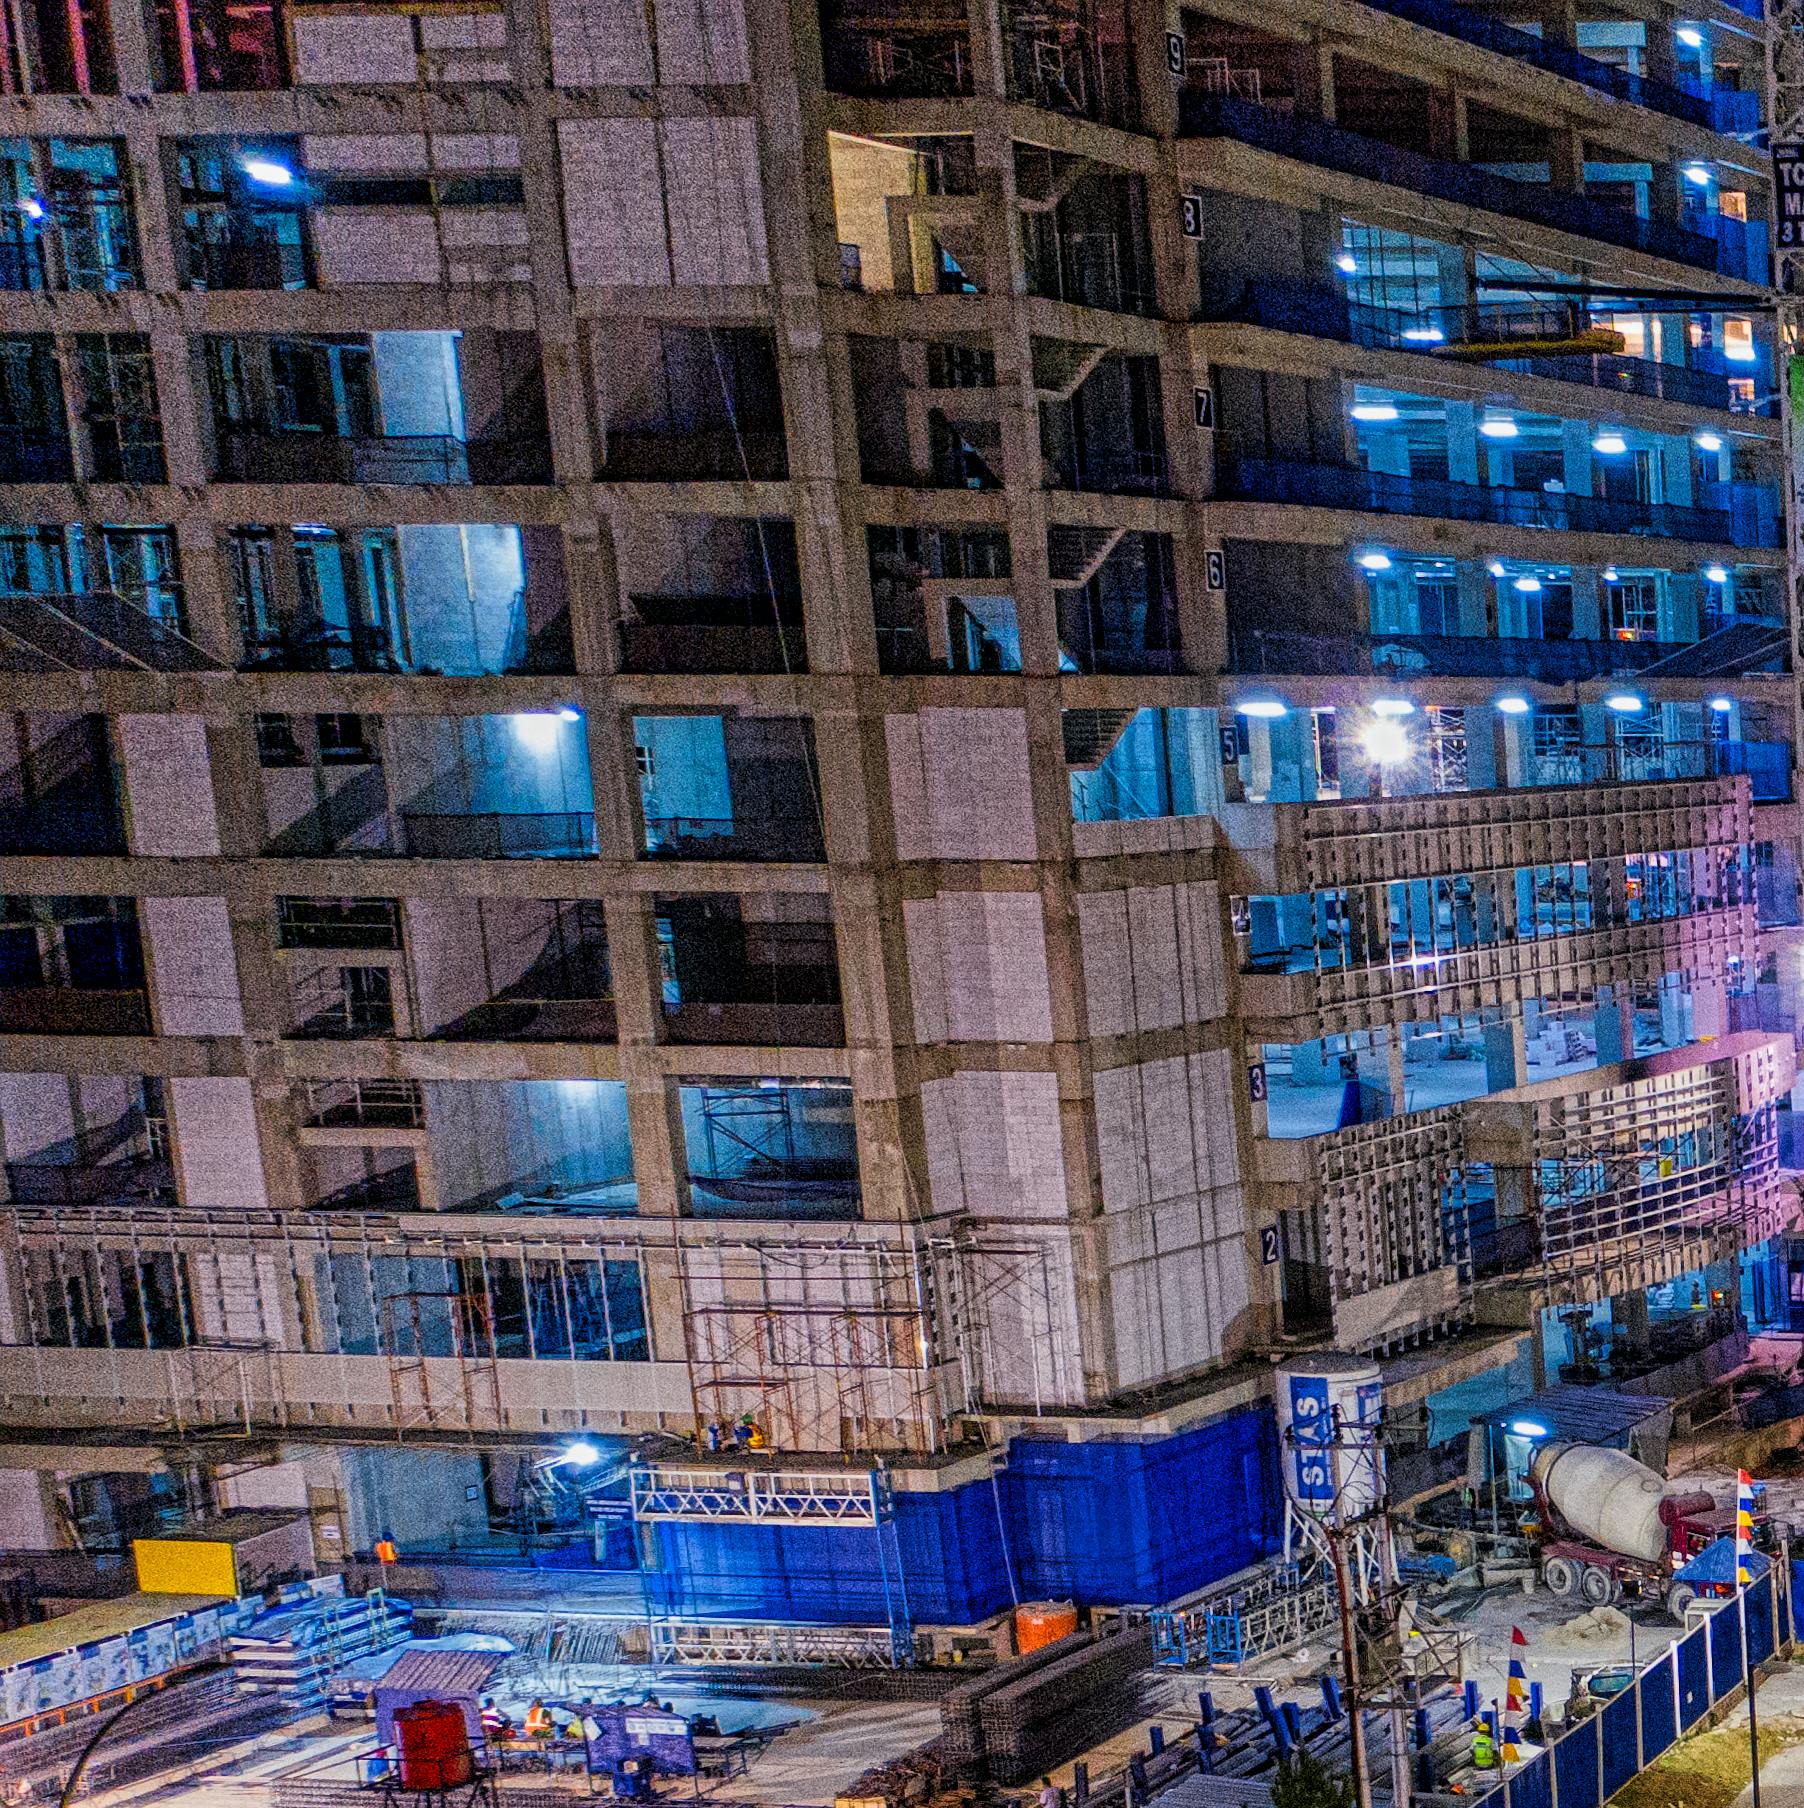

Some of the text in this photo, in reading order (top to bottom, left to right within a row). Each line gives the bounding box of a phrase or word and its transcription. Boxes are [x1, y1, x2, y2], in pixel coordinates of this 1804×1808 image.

[1169, 35, 1181, 71] 9
[1183, 199, 1196, 234] 8
[1781, 221, 1794, 243] 3
[1198, 391, 1208, 424] 7
[1209, 553, 1220, 587] 6
[1223, 730, 1235, 763] 5
[1251, 1067, 1263, 1099] 3
[1265, 1230, 1276, 1261] 2
